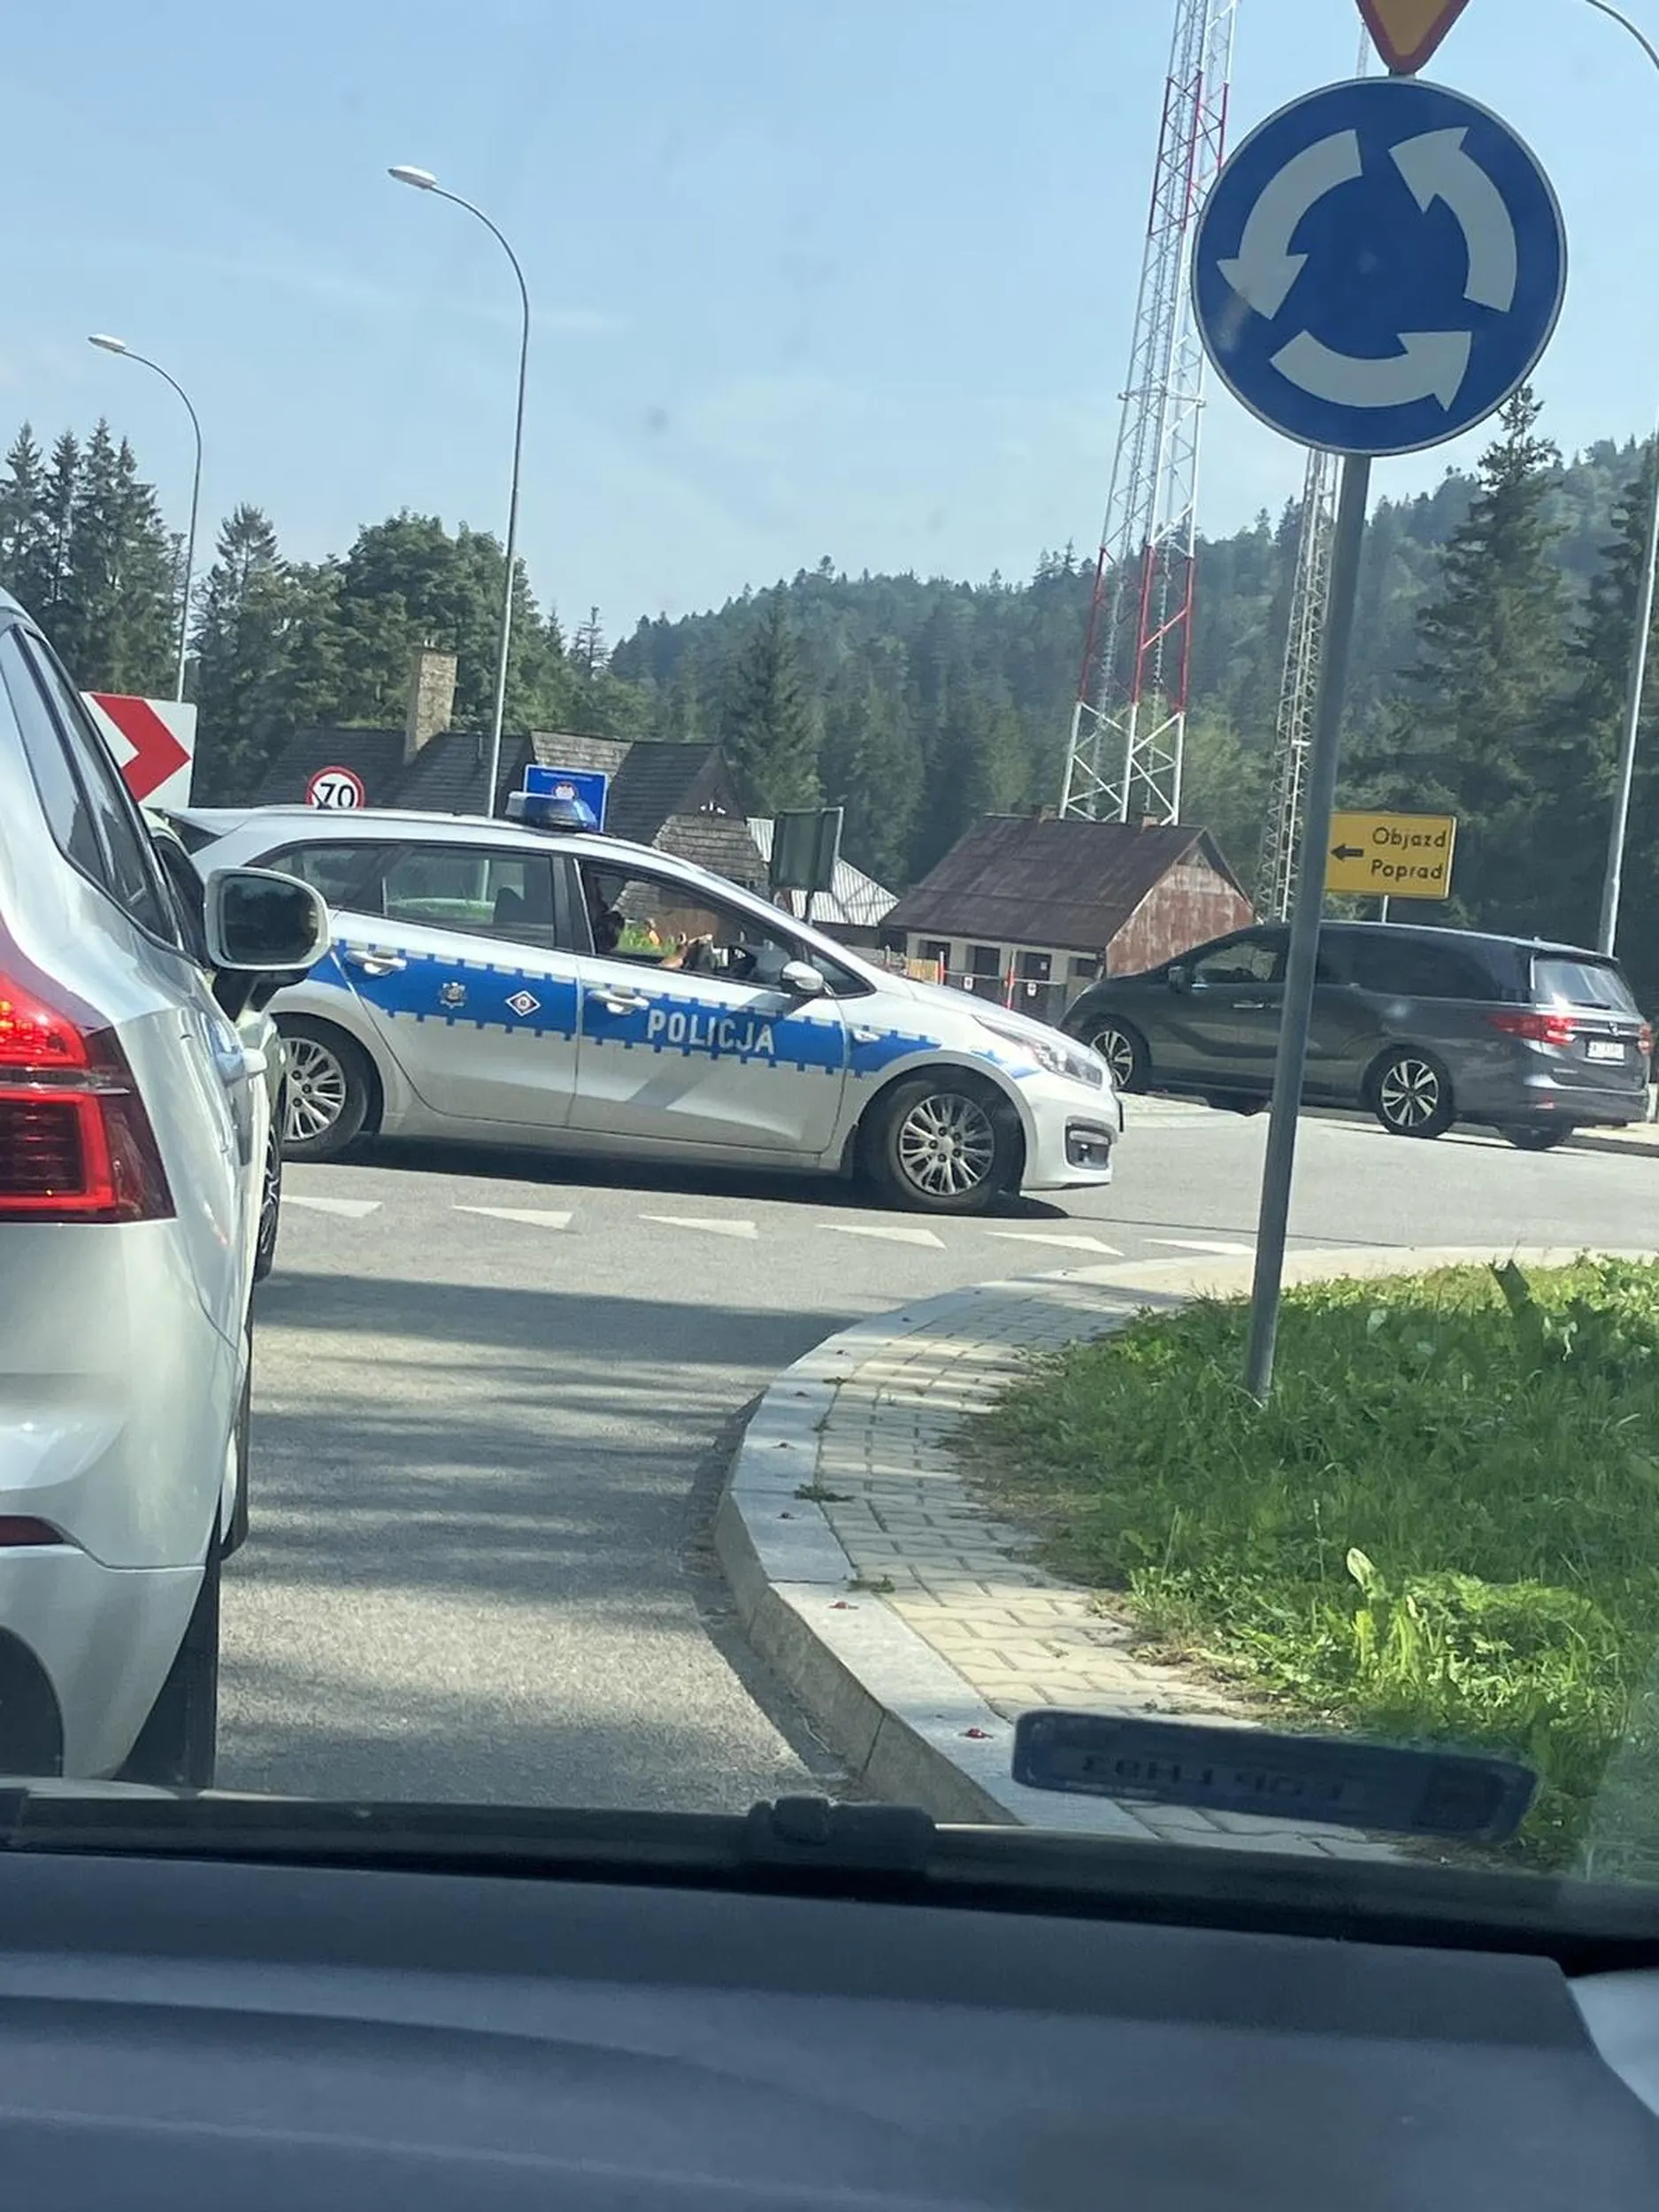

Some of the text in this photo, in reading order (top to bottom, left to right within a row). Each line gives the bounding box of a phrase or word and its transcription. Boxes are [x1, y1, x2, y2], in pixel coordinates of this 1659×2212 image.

[320, 783, 355, 807] 70
[1372, 826, 1447, 849] Objazd
[1371, 858, 1443, 881] Poprad
[647, 1009, 775, 1055] POLICJA
